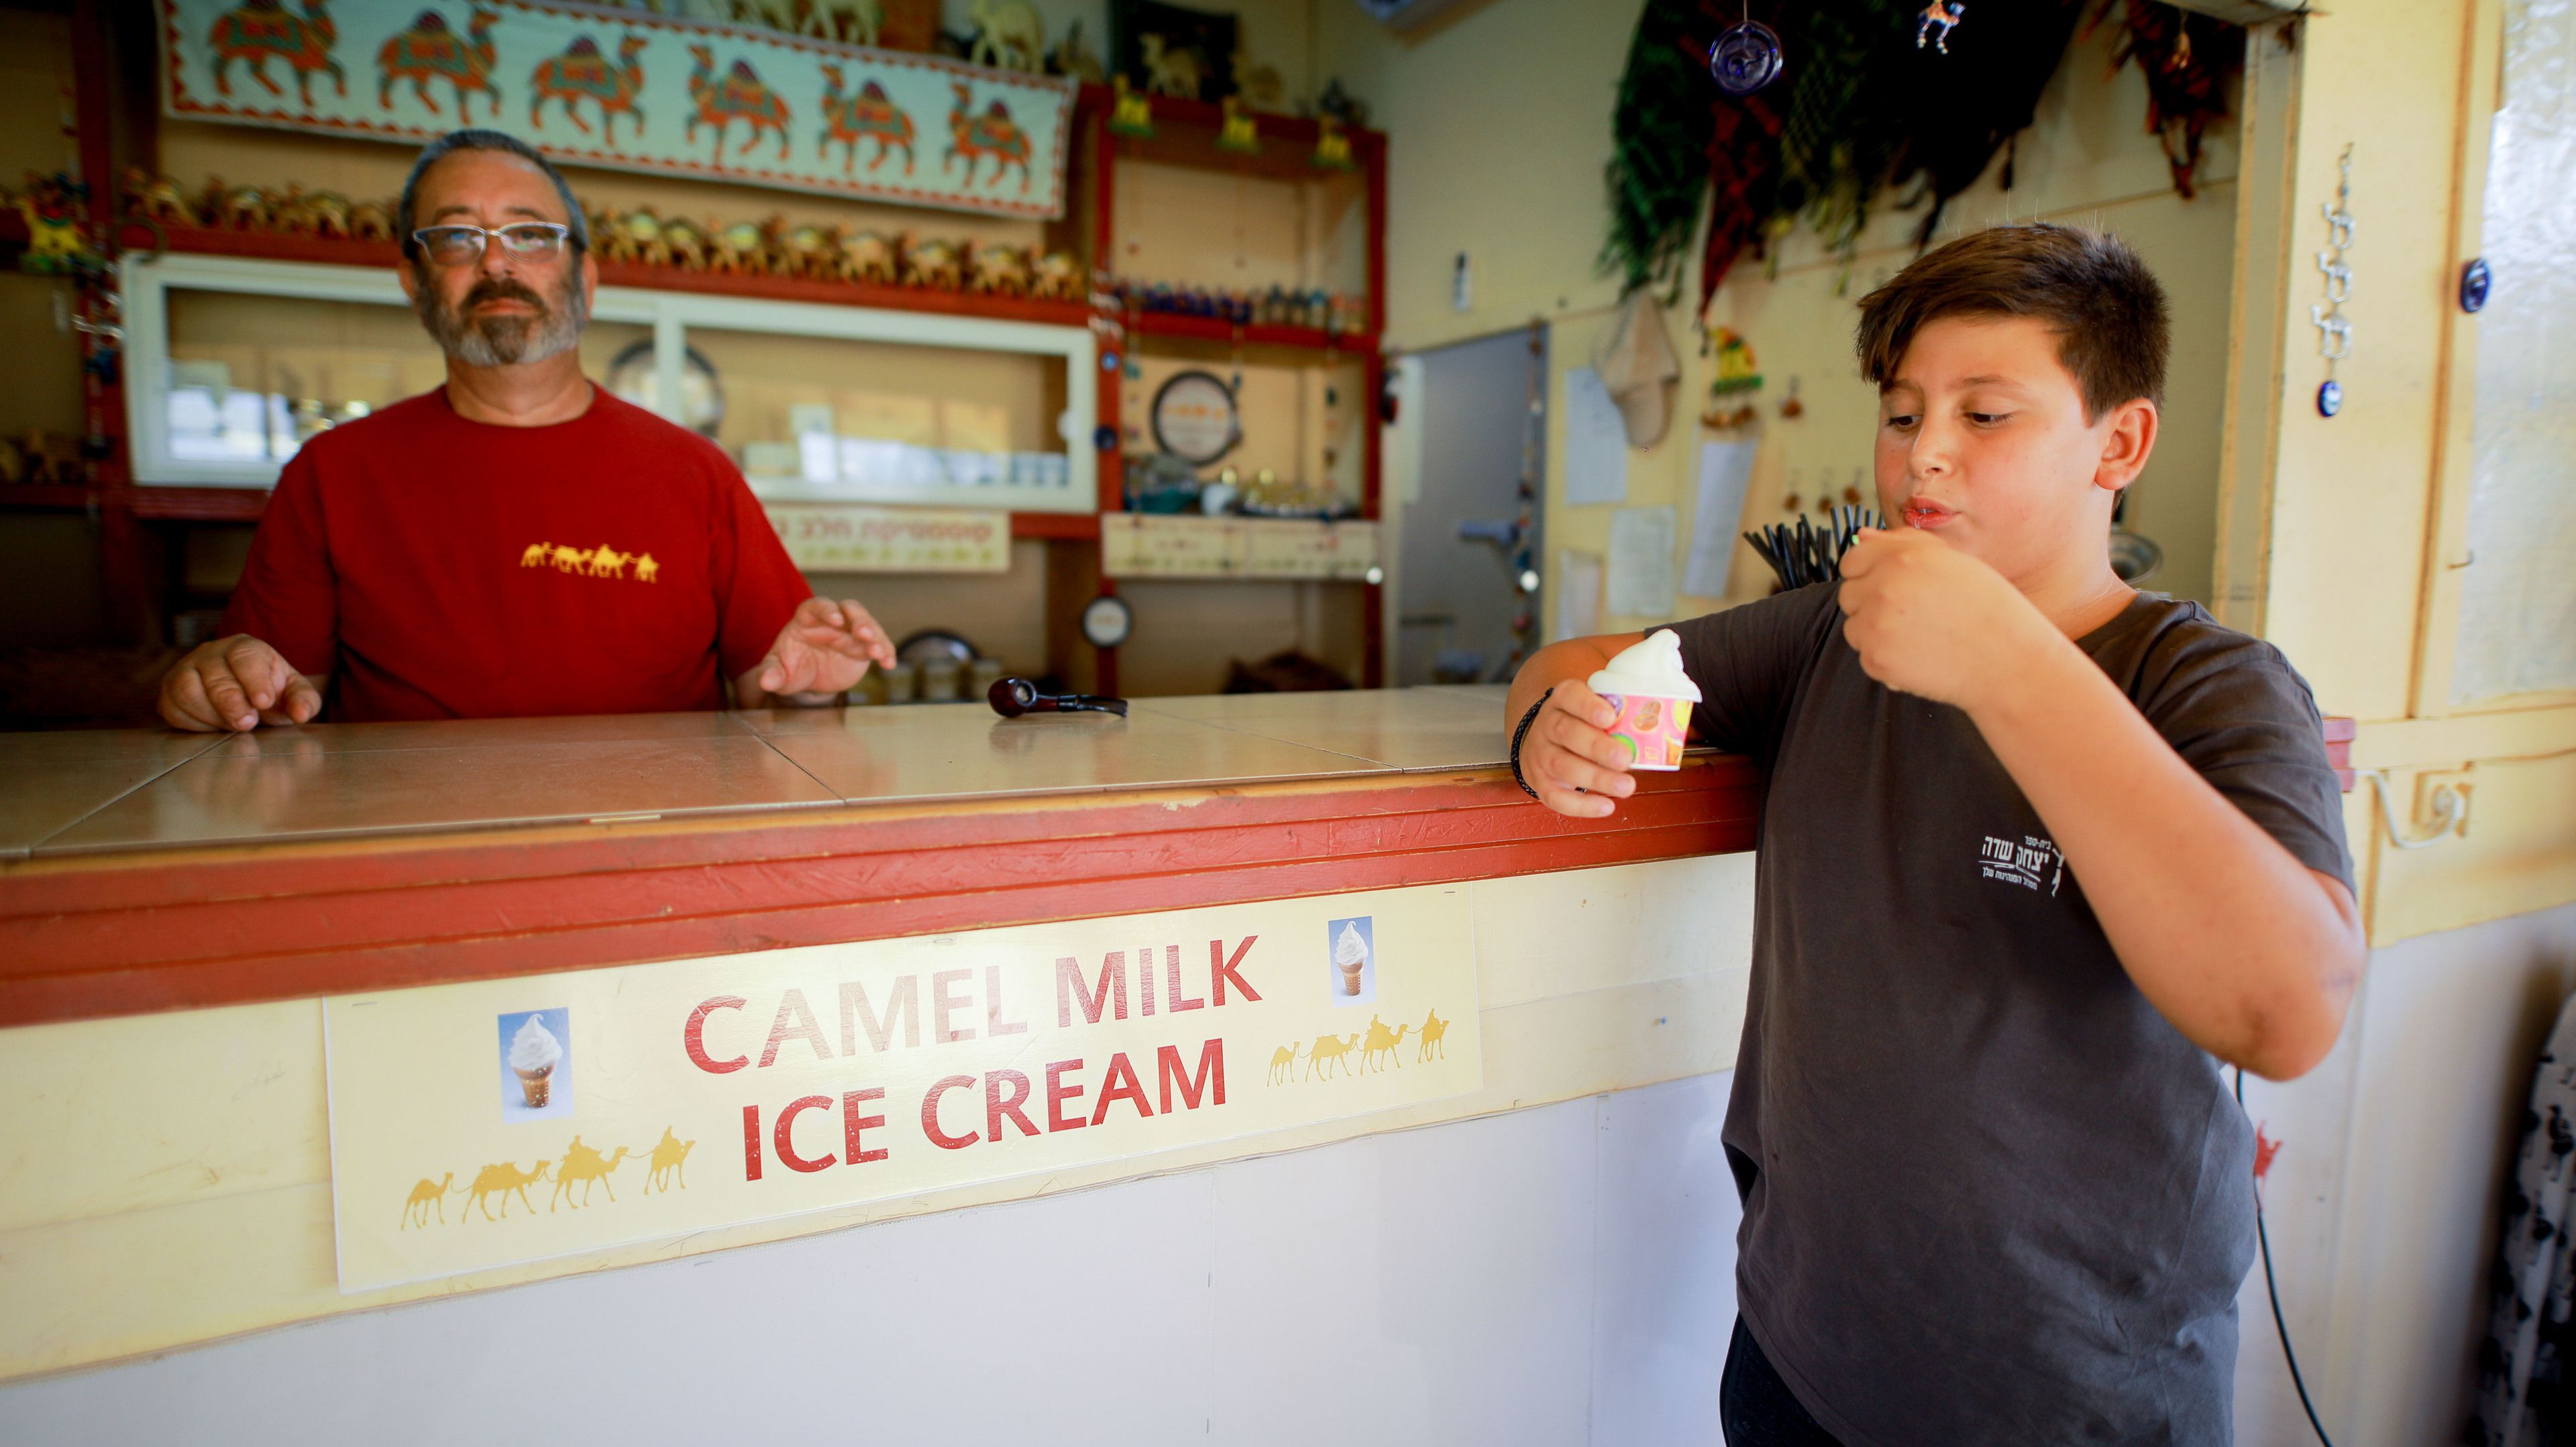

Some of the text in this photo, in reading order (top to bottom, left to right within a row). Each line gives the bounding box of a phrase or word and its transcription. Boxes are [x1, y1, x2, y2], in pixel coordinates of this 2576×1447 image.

[1982, 836, 2049, 871] יצחק שדה
[2025, 835, 2051, 851] בית-ספר
[684, 935, 1263, 1073] CAMEL MILK
[743, 1038, 1226, 1181] ICE CREAM
